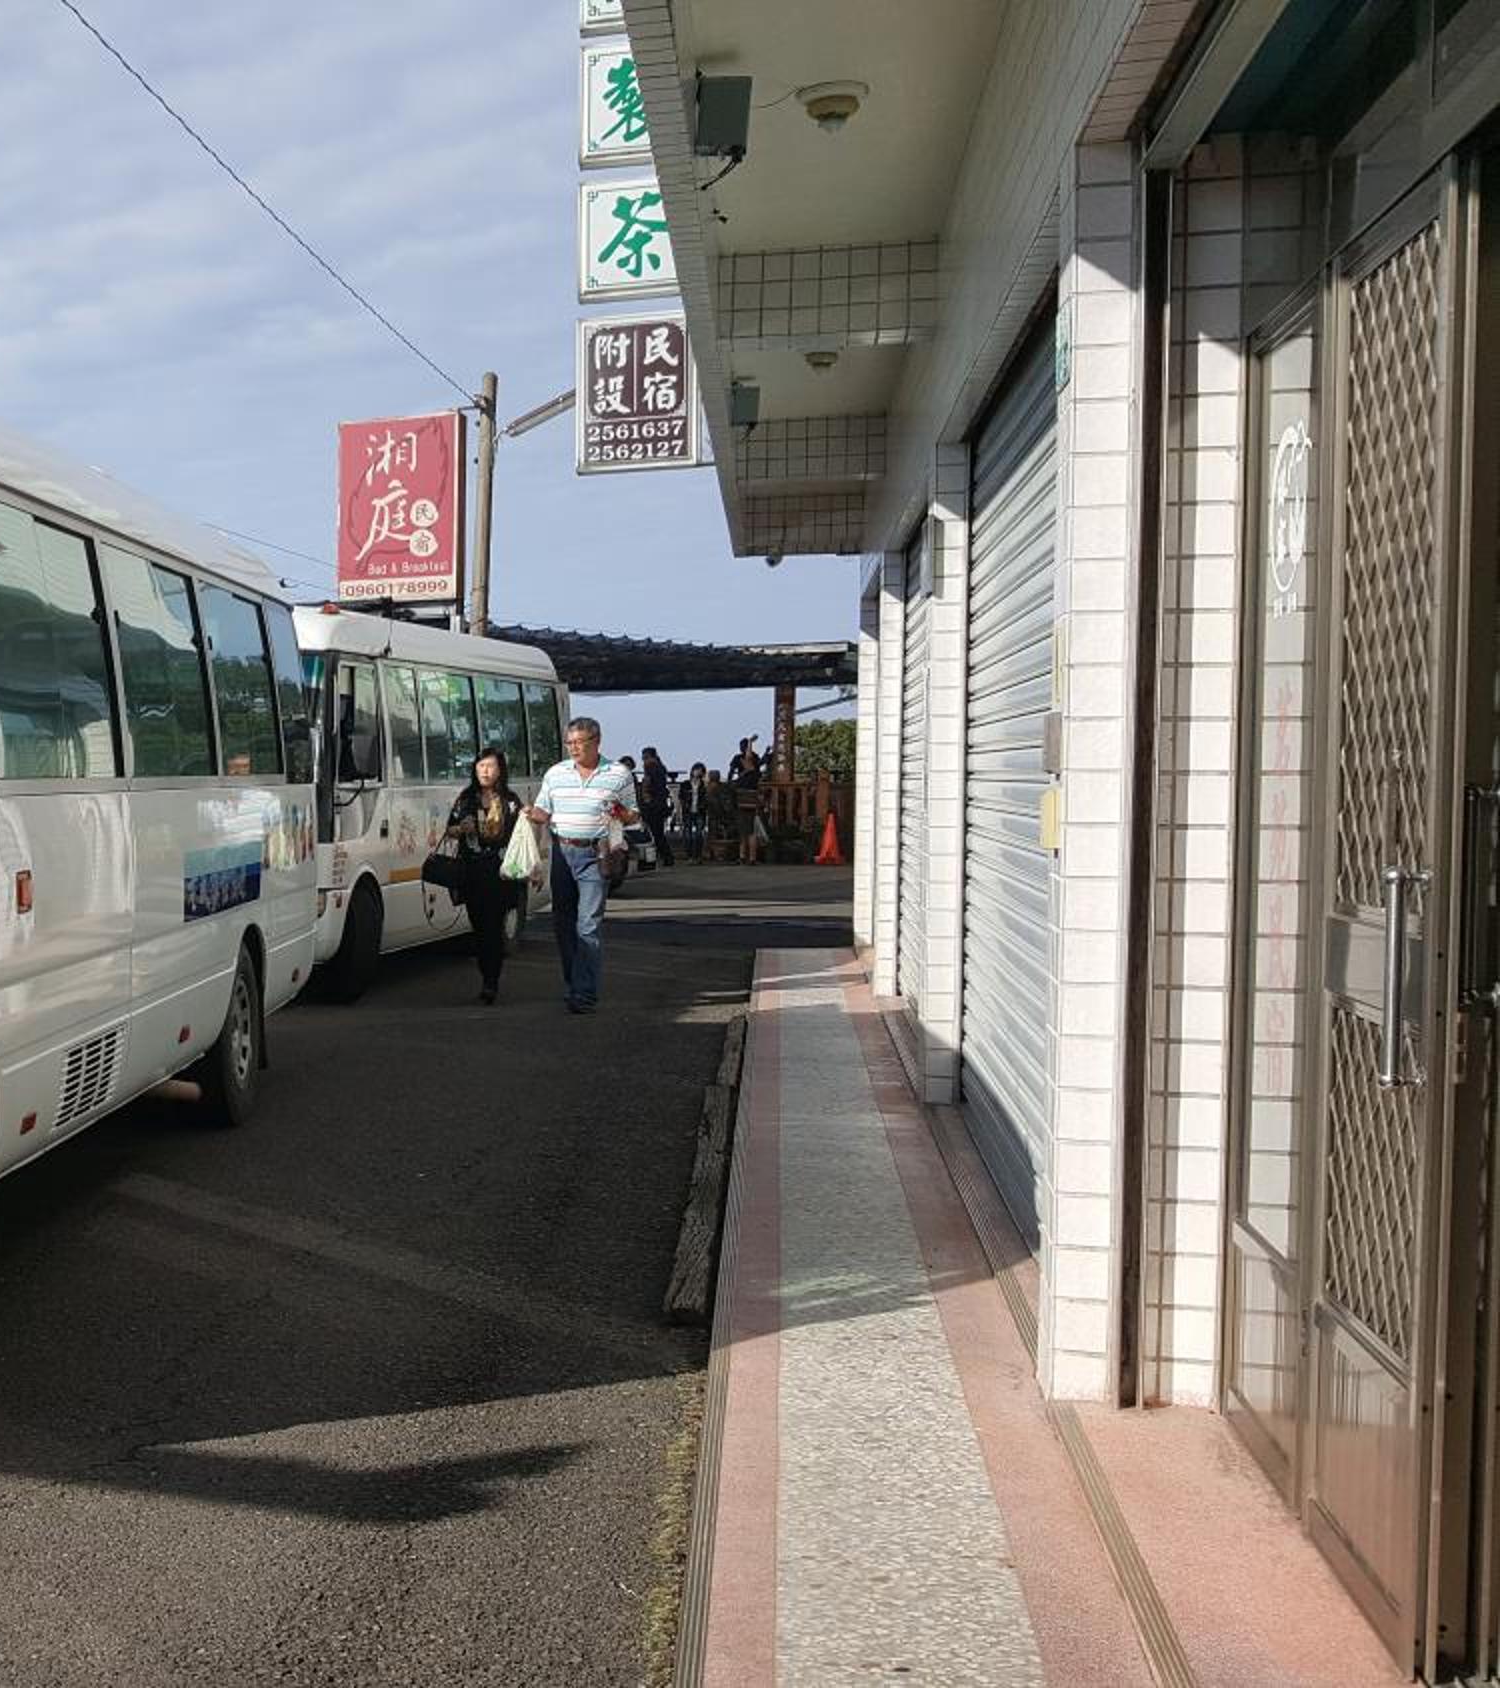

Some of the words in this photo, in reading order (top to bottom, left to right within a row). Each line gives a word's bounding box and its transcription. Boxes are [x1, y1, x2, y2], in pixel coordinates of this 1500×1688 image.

[594, 333, 631, 414] 附設
[643, 327, 679, 411] 民宿
[588, 419, 685, 443] 2561637
[588, 440, 684, 461] 2562127
[355, 430, 417, 561] 湘庭
[344, 580, 448, 597] 0960178999
